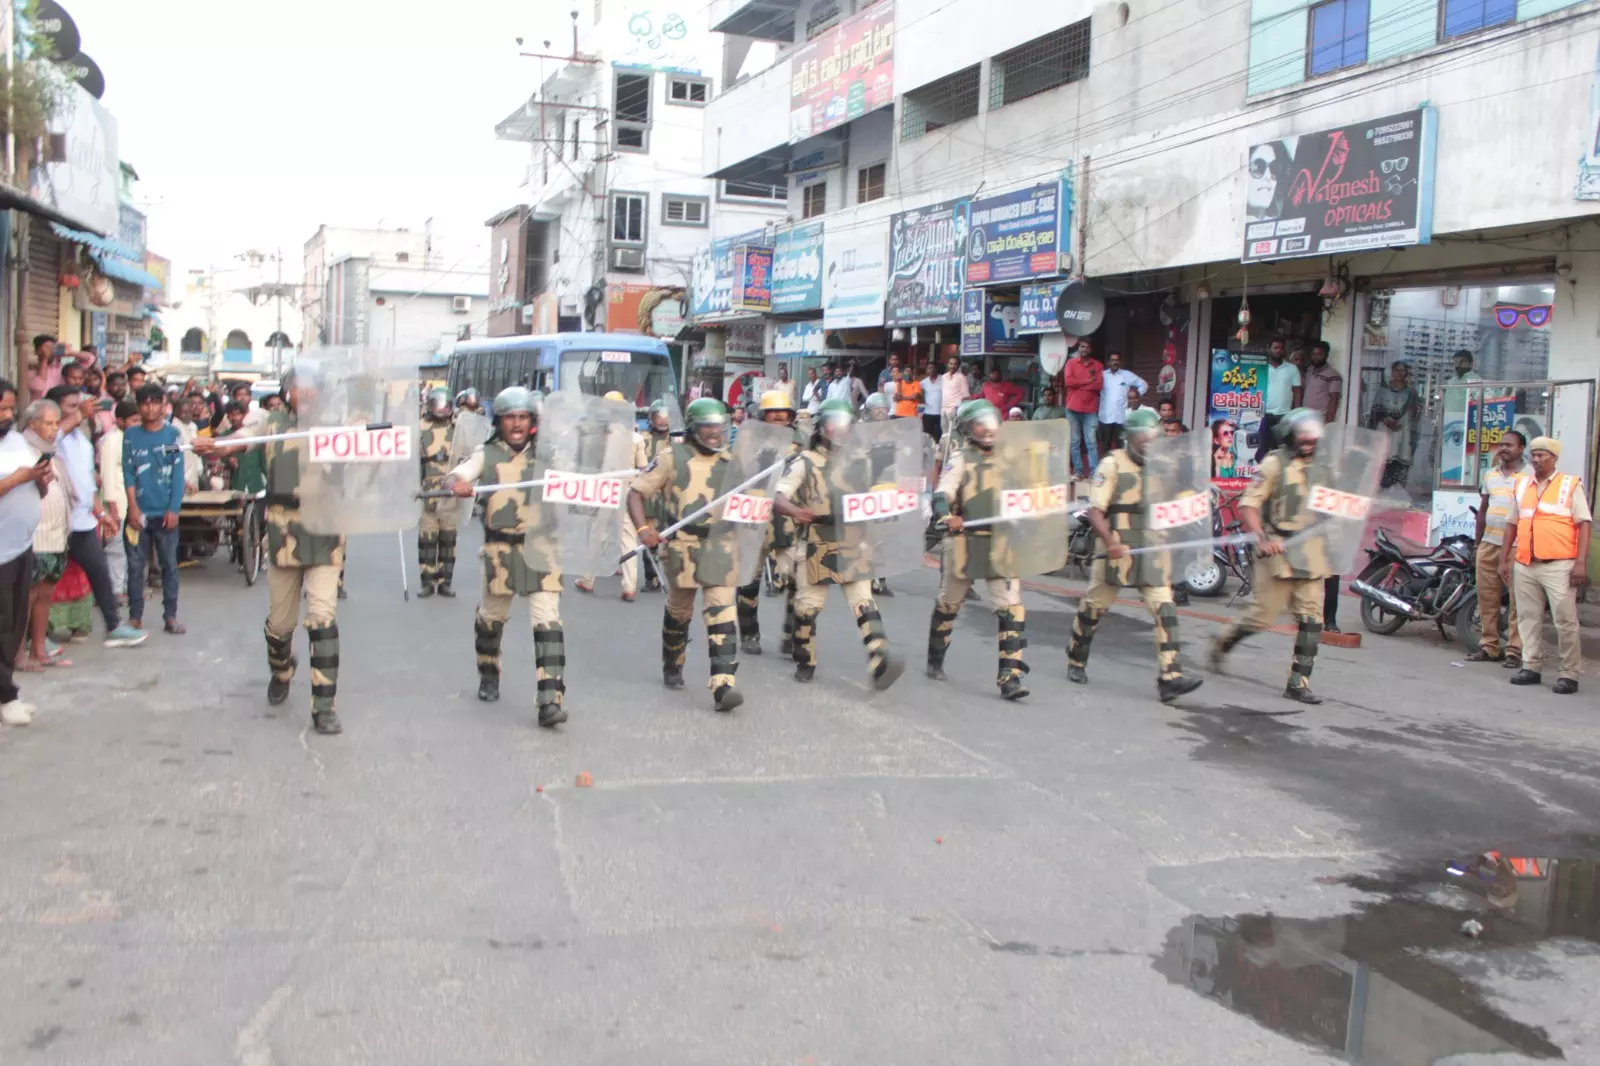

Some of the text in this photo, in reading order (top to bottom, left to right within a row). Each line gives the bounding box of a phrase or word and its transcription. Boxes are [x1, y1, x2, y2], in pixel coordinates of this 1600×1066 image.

[1288, 131, 1380, 207] Vignesh
[1324, 199, 1392, 227] OPTICALS
[887, 216, 929, 291] Lucky
[927, 219, 955, 256] HAIR
[1022, 299, 1039, 313] ALL
[314, 431, 407, 457] POLICE
[546, 475, 620, 505] POLICE
[847, 488, 916, 516] POLICE
